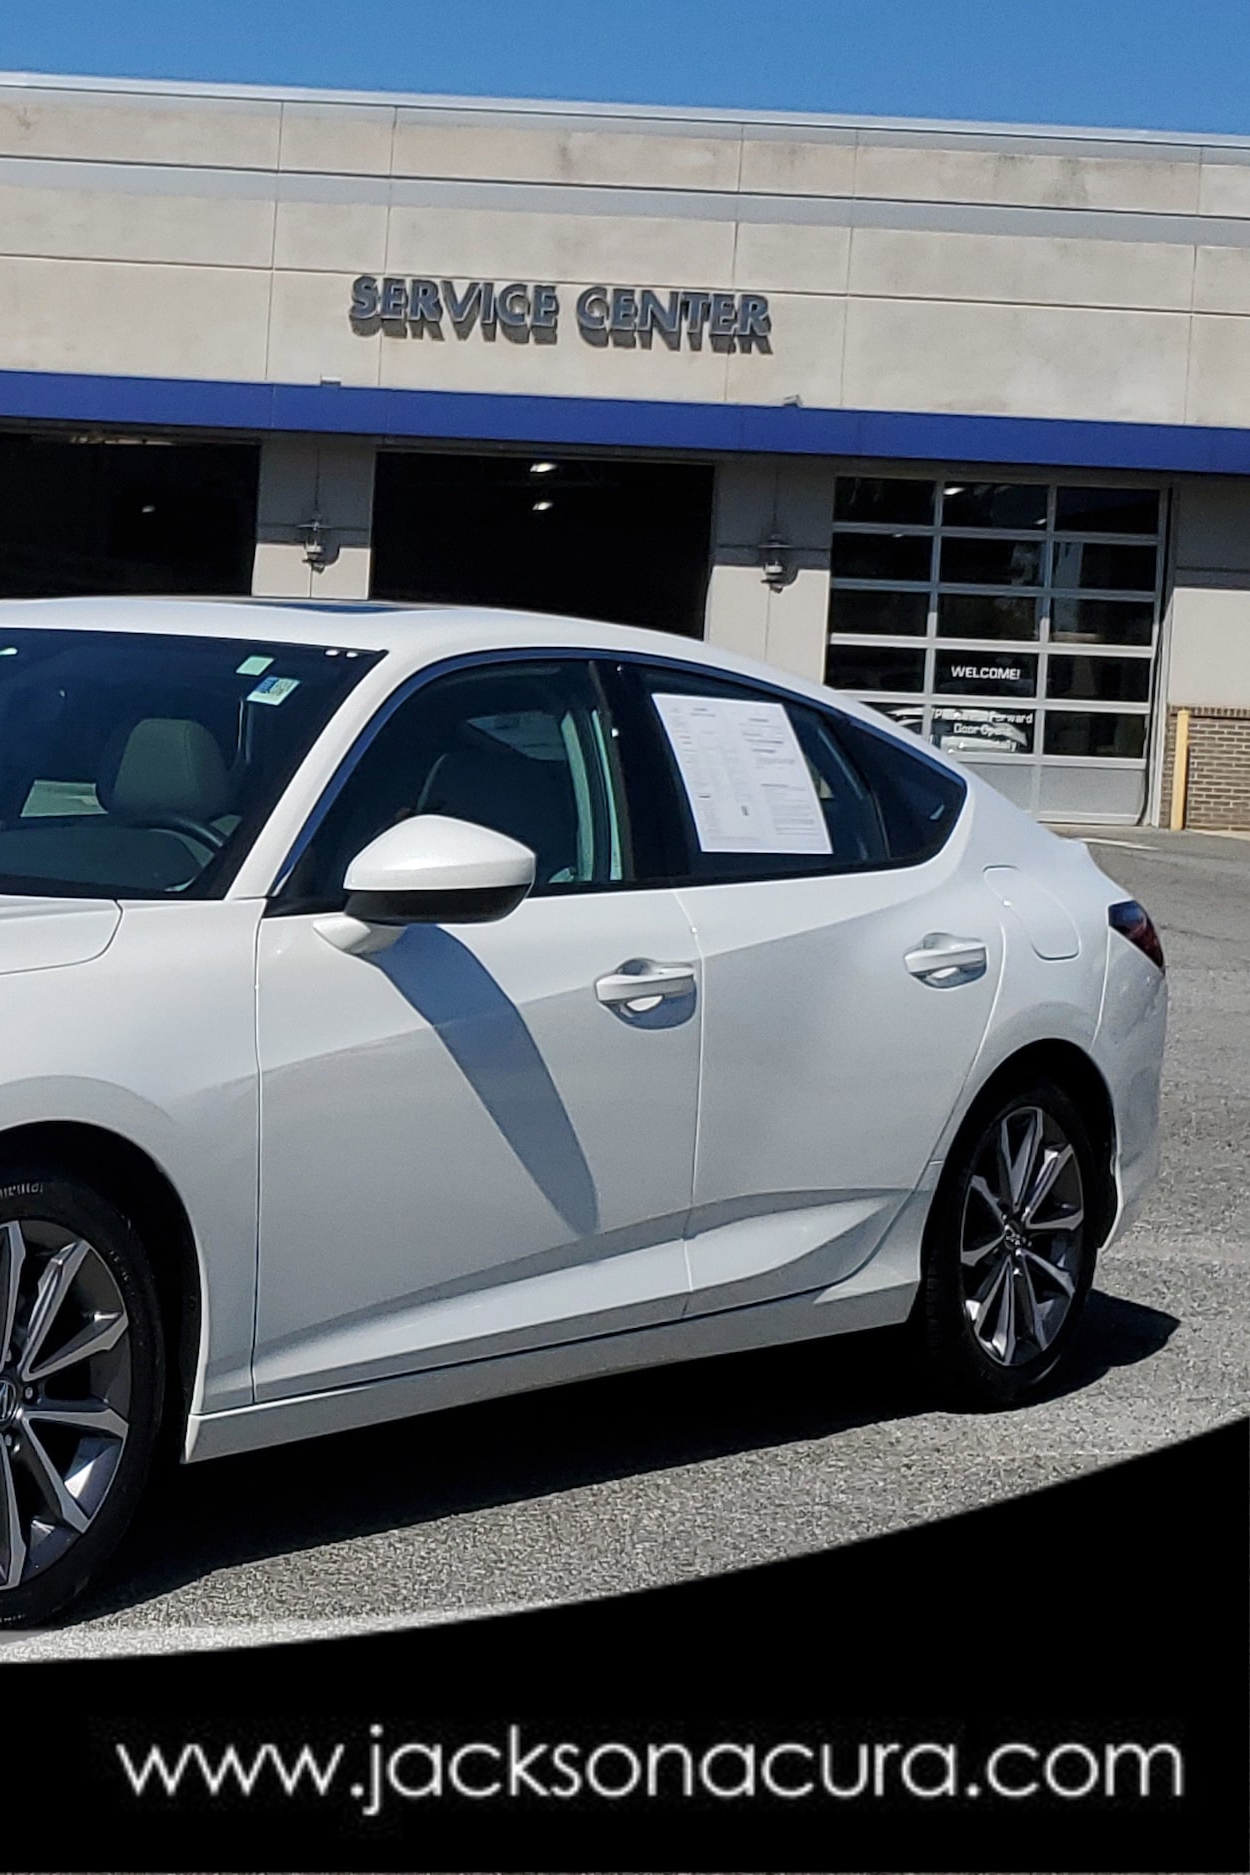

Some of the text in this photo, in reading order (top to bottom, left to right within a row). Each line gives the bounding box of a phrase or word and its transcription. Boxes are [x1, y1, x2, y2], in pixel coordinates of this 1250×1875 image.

[350, 275, 772, 337] SERVICE CENTER
[951, 665, 1021, 681] WELCOME!
